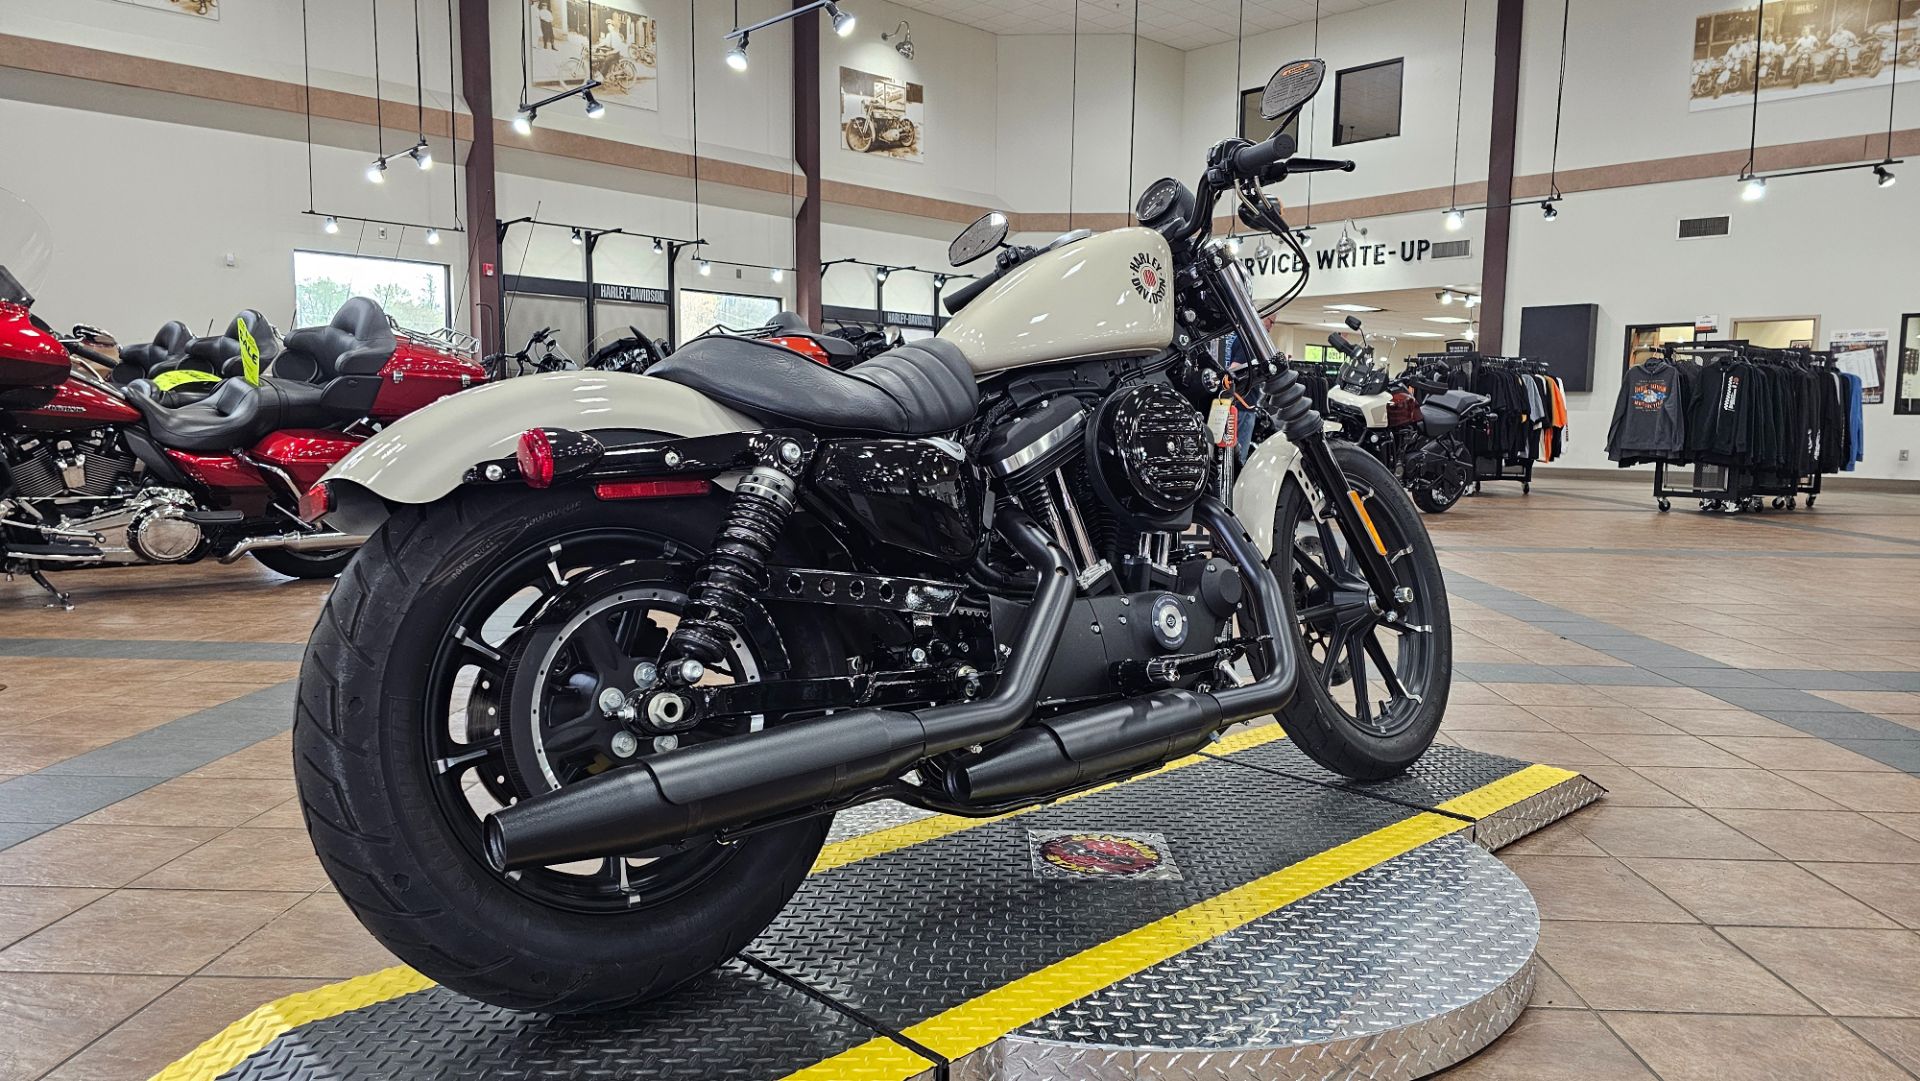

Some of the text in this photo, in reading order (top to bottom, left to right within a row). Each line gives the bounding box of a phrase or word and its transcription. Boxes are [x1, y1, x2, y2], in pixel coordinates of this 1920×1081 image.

[1129, 252, 1162, 273] HARLEY
[1240, 239, 1430, 276] RVICE WRITE-UP
[600, 284, 665, 303] HARLEY-DAVIDSON
[887, 312, 933, 327] HARLEY-DAVIDSON
